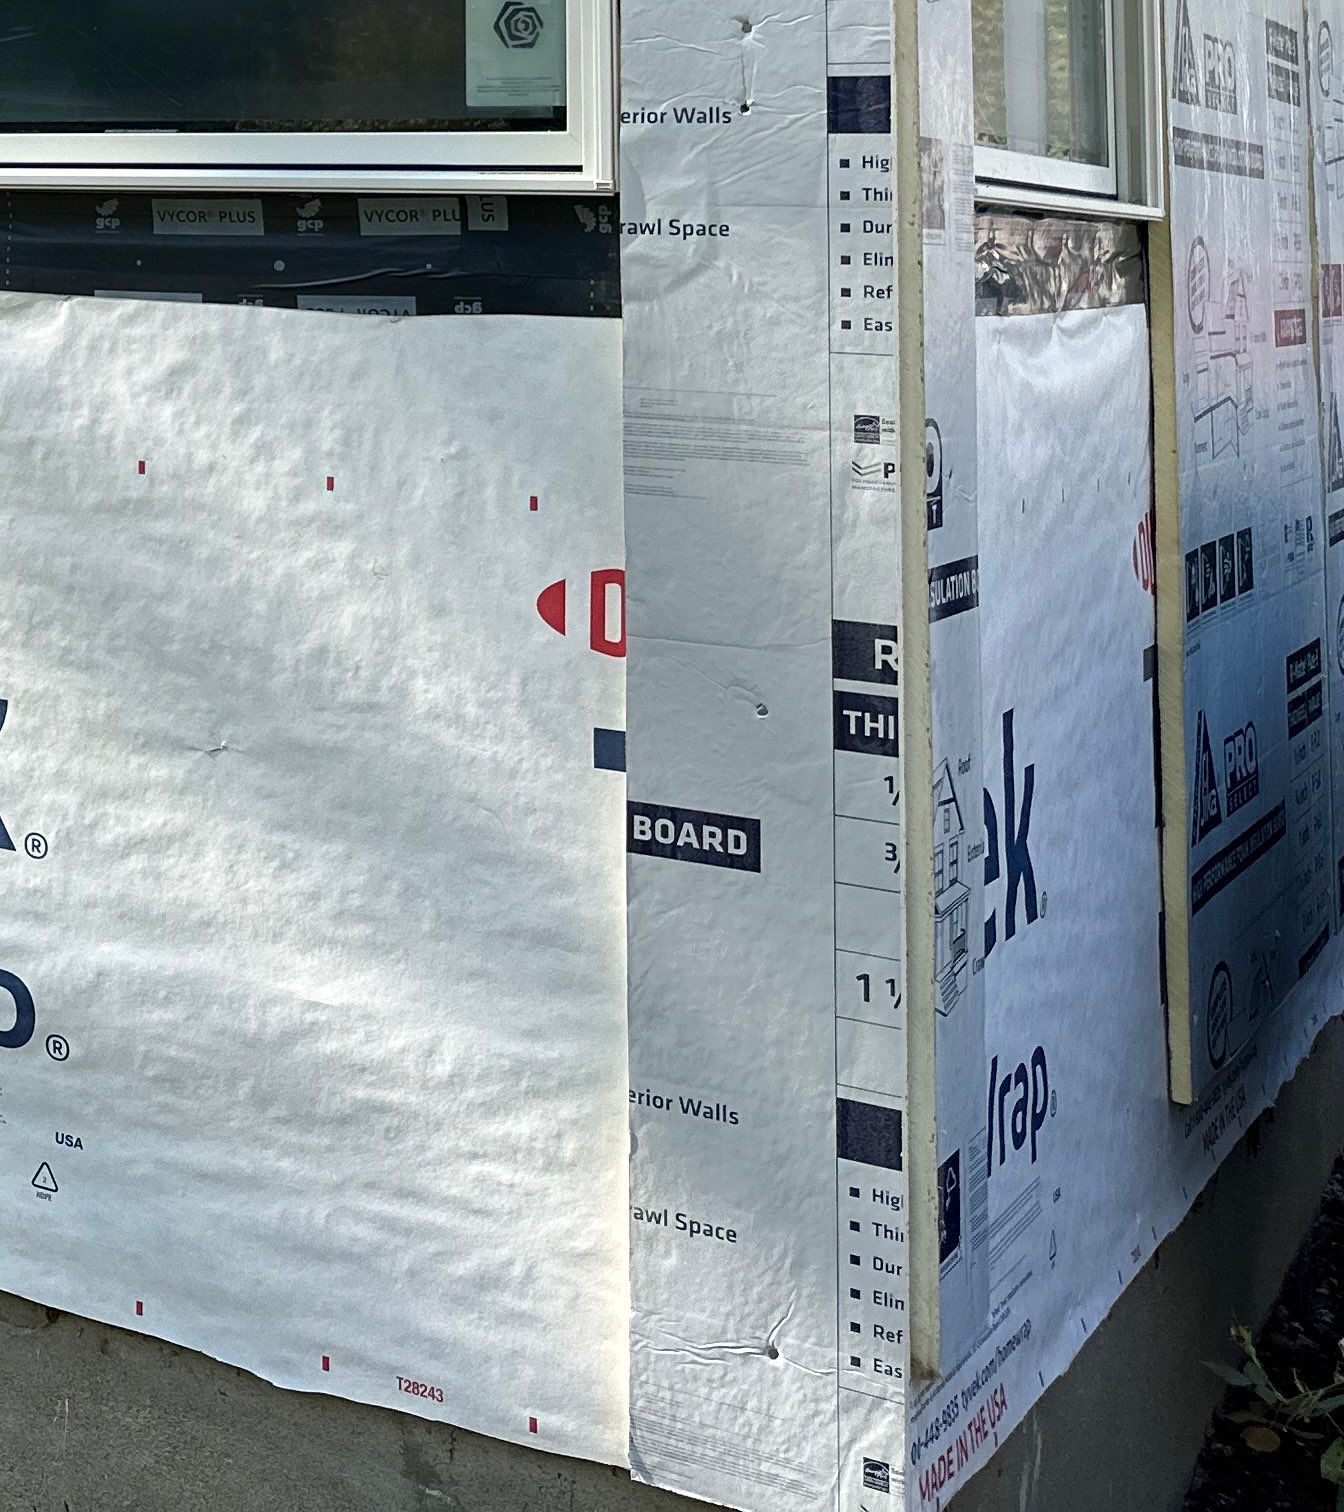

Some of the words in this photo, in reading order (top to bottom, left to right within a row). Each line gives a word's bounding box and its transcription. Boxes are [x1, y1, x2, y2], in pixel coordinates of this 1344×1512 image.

[672, 106, 732, 125] Walls
[219, 210, 256, 225] PLUS
[668, 218, 730, 241] Space
[632, 817, 747, 857] BOARD
[678, 1096, 740, 1126] Walls
[55, 1131, 84, 1150] USA
[673, 1212, 738, 1245] Space
